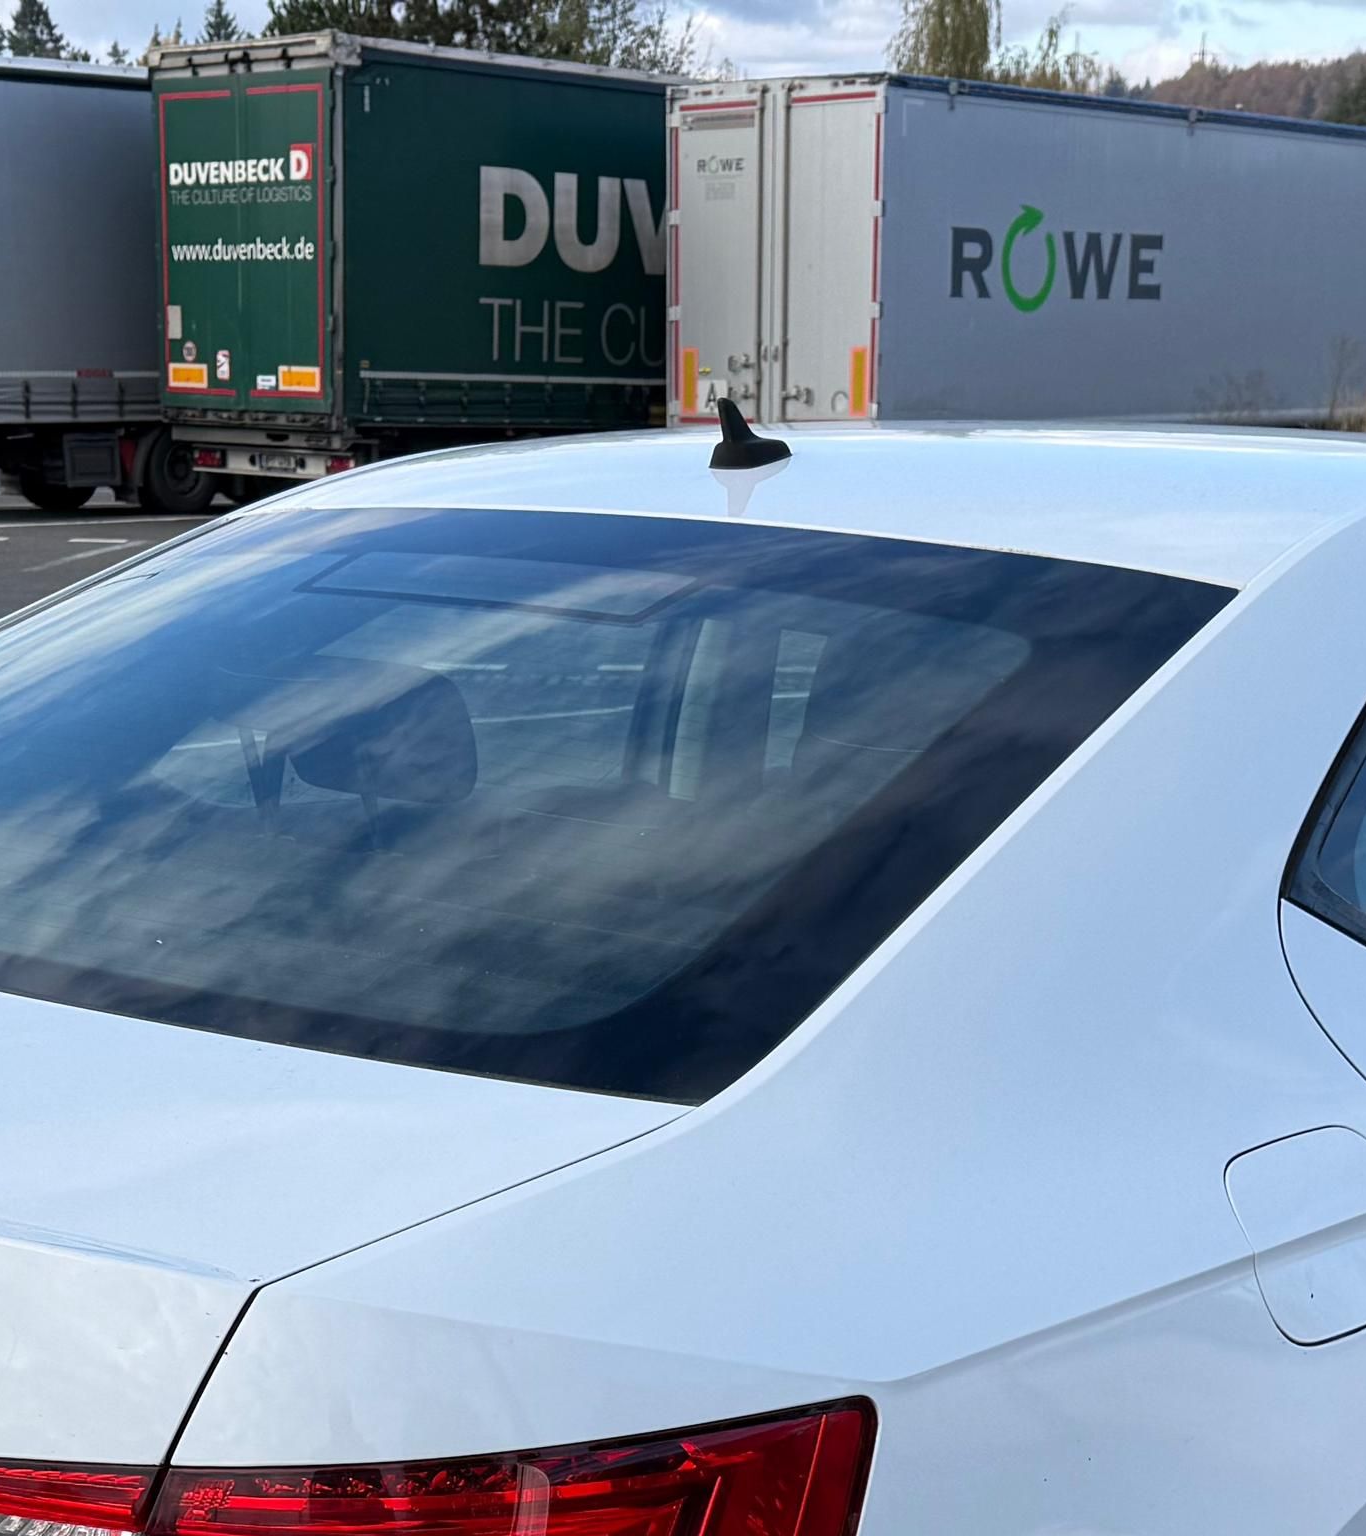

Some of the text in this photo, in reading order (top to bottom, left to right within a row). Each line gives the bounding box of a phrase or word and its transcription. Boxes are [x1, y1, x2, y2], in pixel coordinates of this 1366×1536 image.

[169, 158, 285, 185] DUVENBECK
[170, 185, 313, 206] THE CULTURE OF LOGISTICS
[171, 236, 315, 262] www.duvenbeck.de
[949, 204, 1164, 314] ROWE
[479, 297, 584, 364] THE
